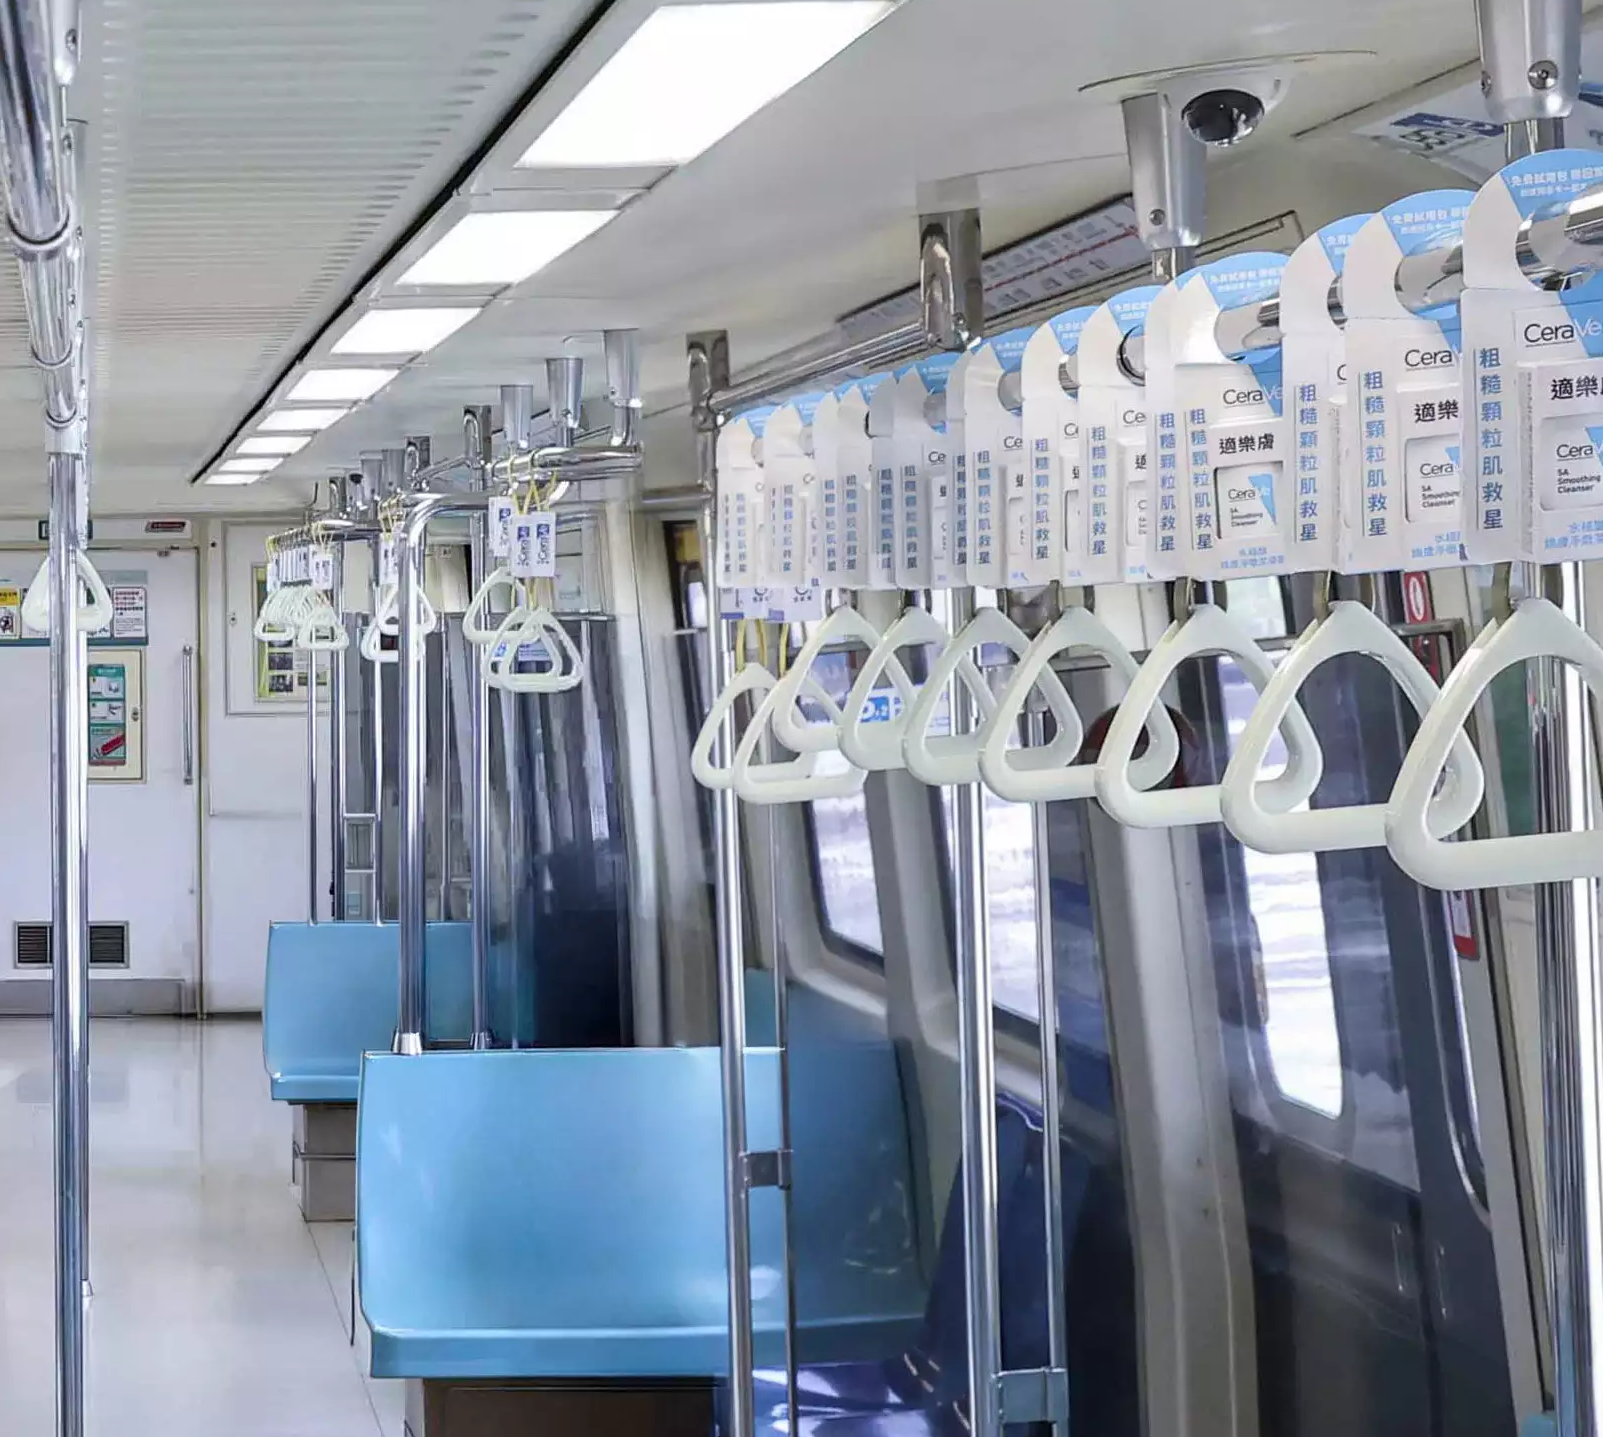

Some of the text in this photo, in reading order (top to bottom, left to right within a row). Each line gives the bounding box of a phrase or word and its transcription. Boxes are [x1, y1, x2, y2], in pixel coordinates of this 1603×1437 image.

[1524, 319, 1602, 344] CeraVe
[1405, 348, 1453, 368] Cera
[1414, 400, 1459, 424] 適樂
[1218, 432, 1275, 455] 適樂膚
[1479, 347, 1503, 530] 粗糙顆粒肌救星
[1299, 383, 1319, 543] 粗糙顆粒肌救星
[1363, 370, 1387, 537] 粗糙顆粒肌救星
[1159, 412, 1176, 552] 粗糙顆粒肌救星
[1189, 408, 1214, 551] 粗糙顆粒肌救星
[1419, 462, 1455, 477] Cera
[1557, 473, 1601, 486] Smoothing
